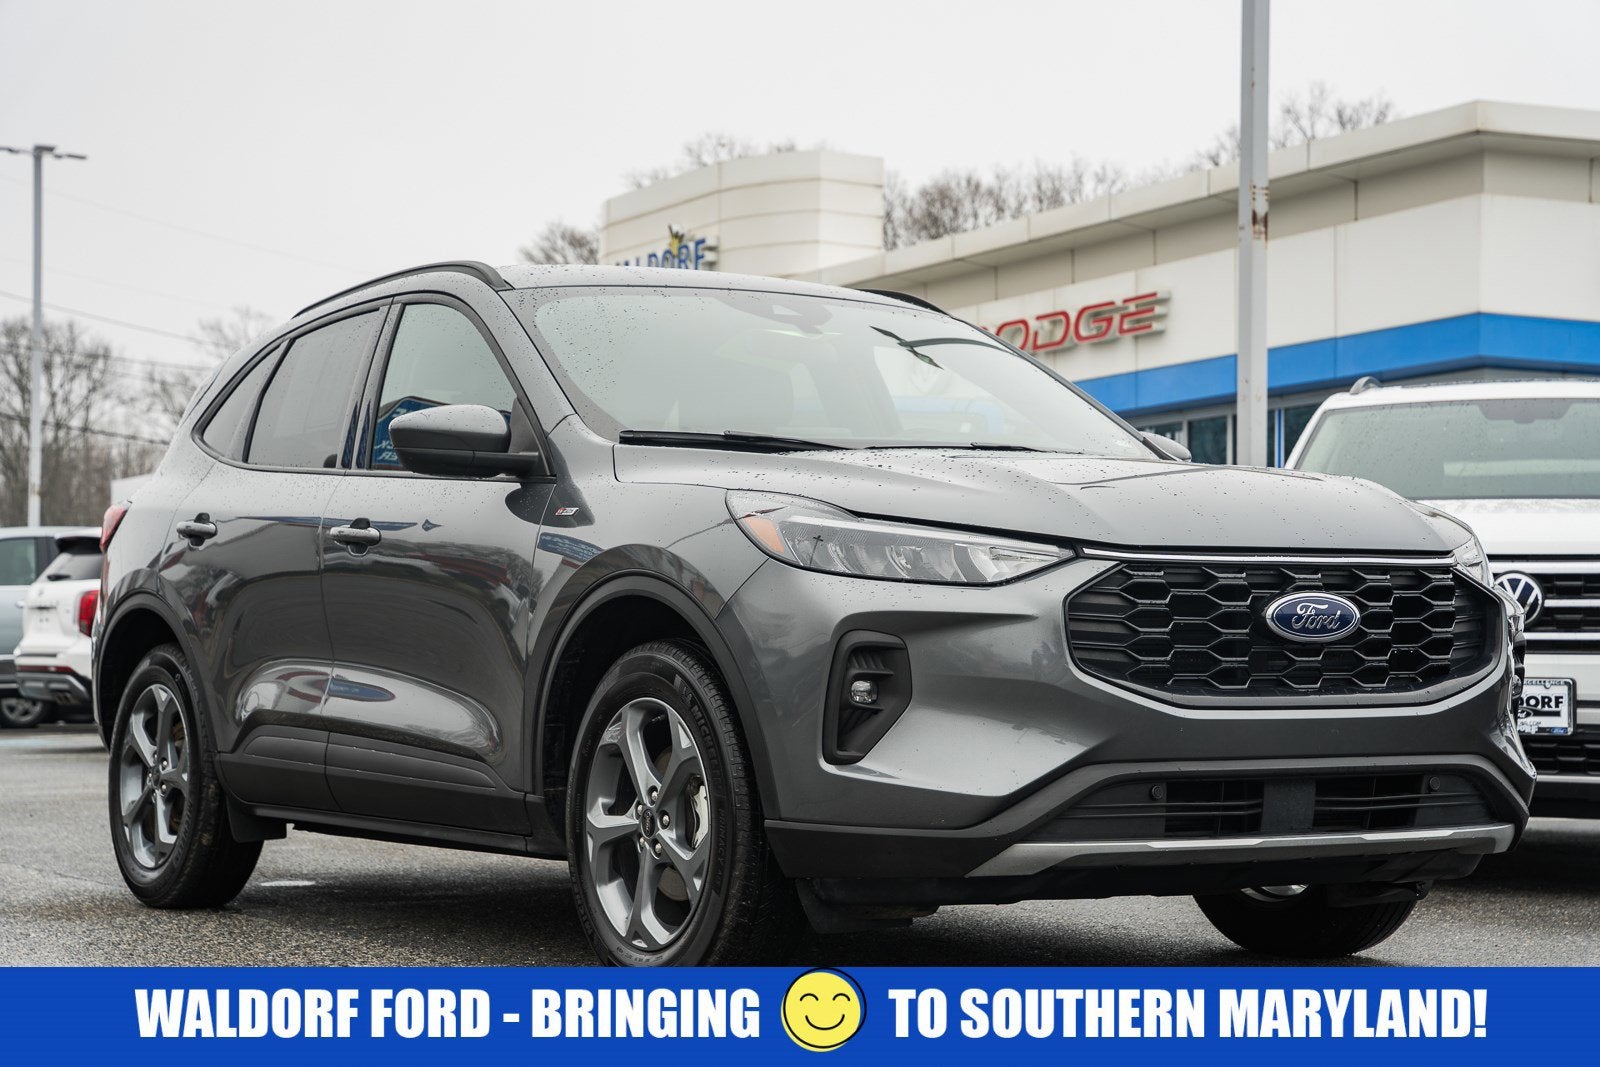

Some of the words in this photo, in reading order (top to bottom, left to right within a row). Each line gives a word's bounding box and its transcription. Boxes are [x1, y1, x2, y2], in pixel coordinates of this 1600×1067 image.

[615, 238, 706, 270] DORF
[981, 292, 1158, 352] ODGE
[1291, 602, 1341, 630] Ford
